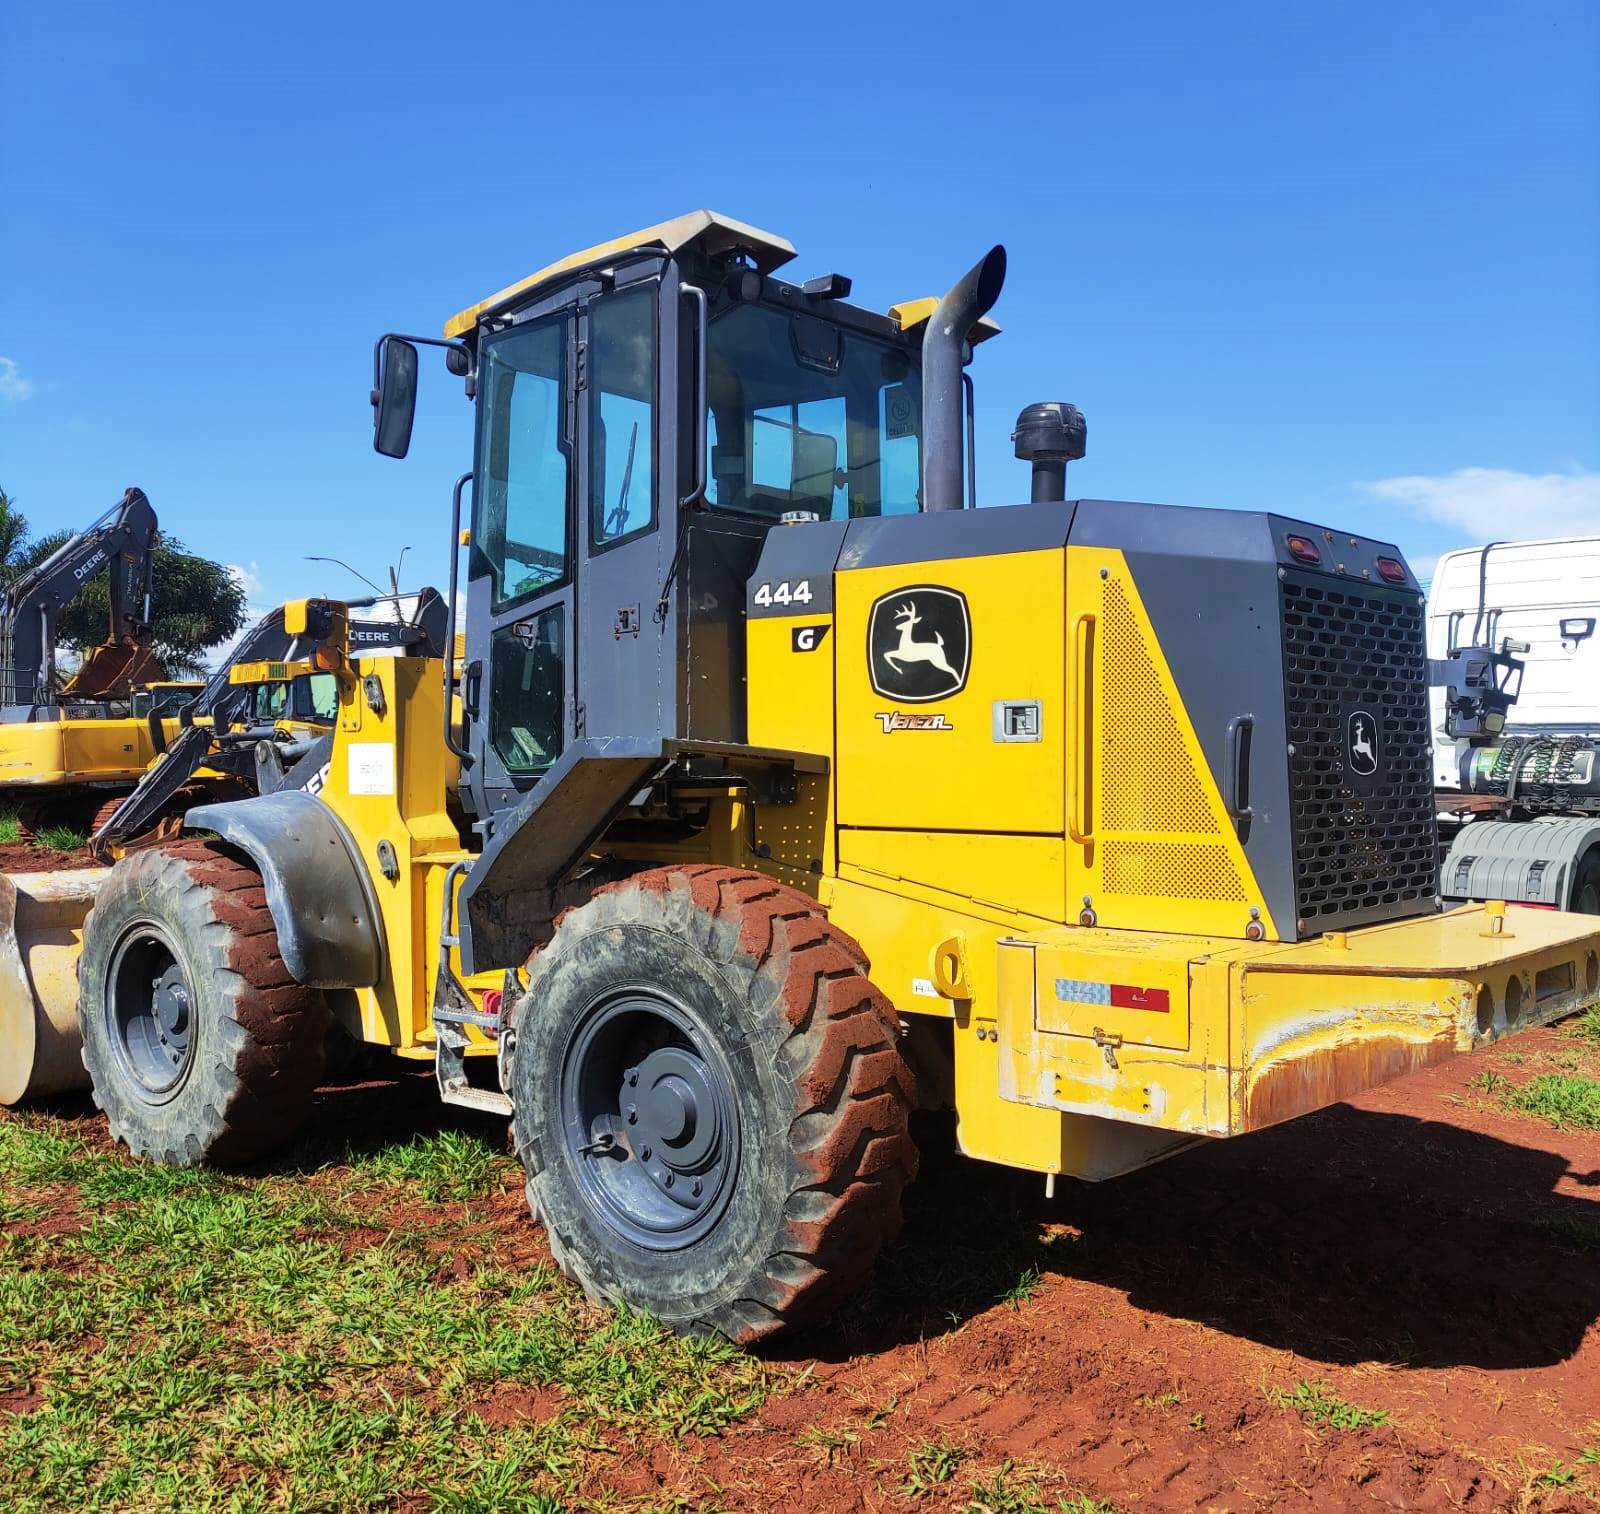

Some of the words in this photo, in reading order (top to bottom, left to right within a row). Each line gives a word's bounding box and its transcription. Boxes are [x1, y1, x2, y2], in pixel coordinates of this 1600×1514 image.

[73, 548, 106, 580] DEERE
[754, 580, 813, 608] 444
[349, 630, 390, 641] DEERE
[797, 629, 815, 650] G
